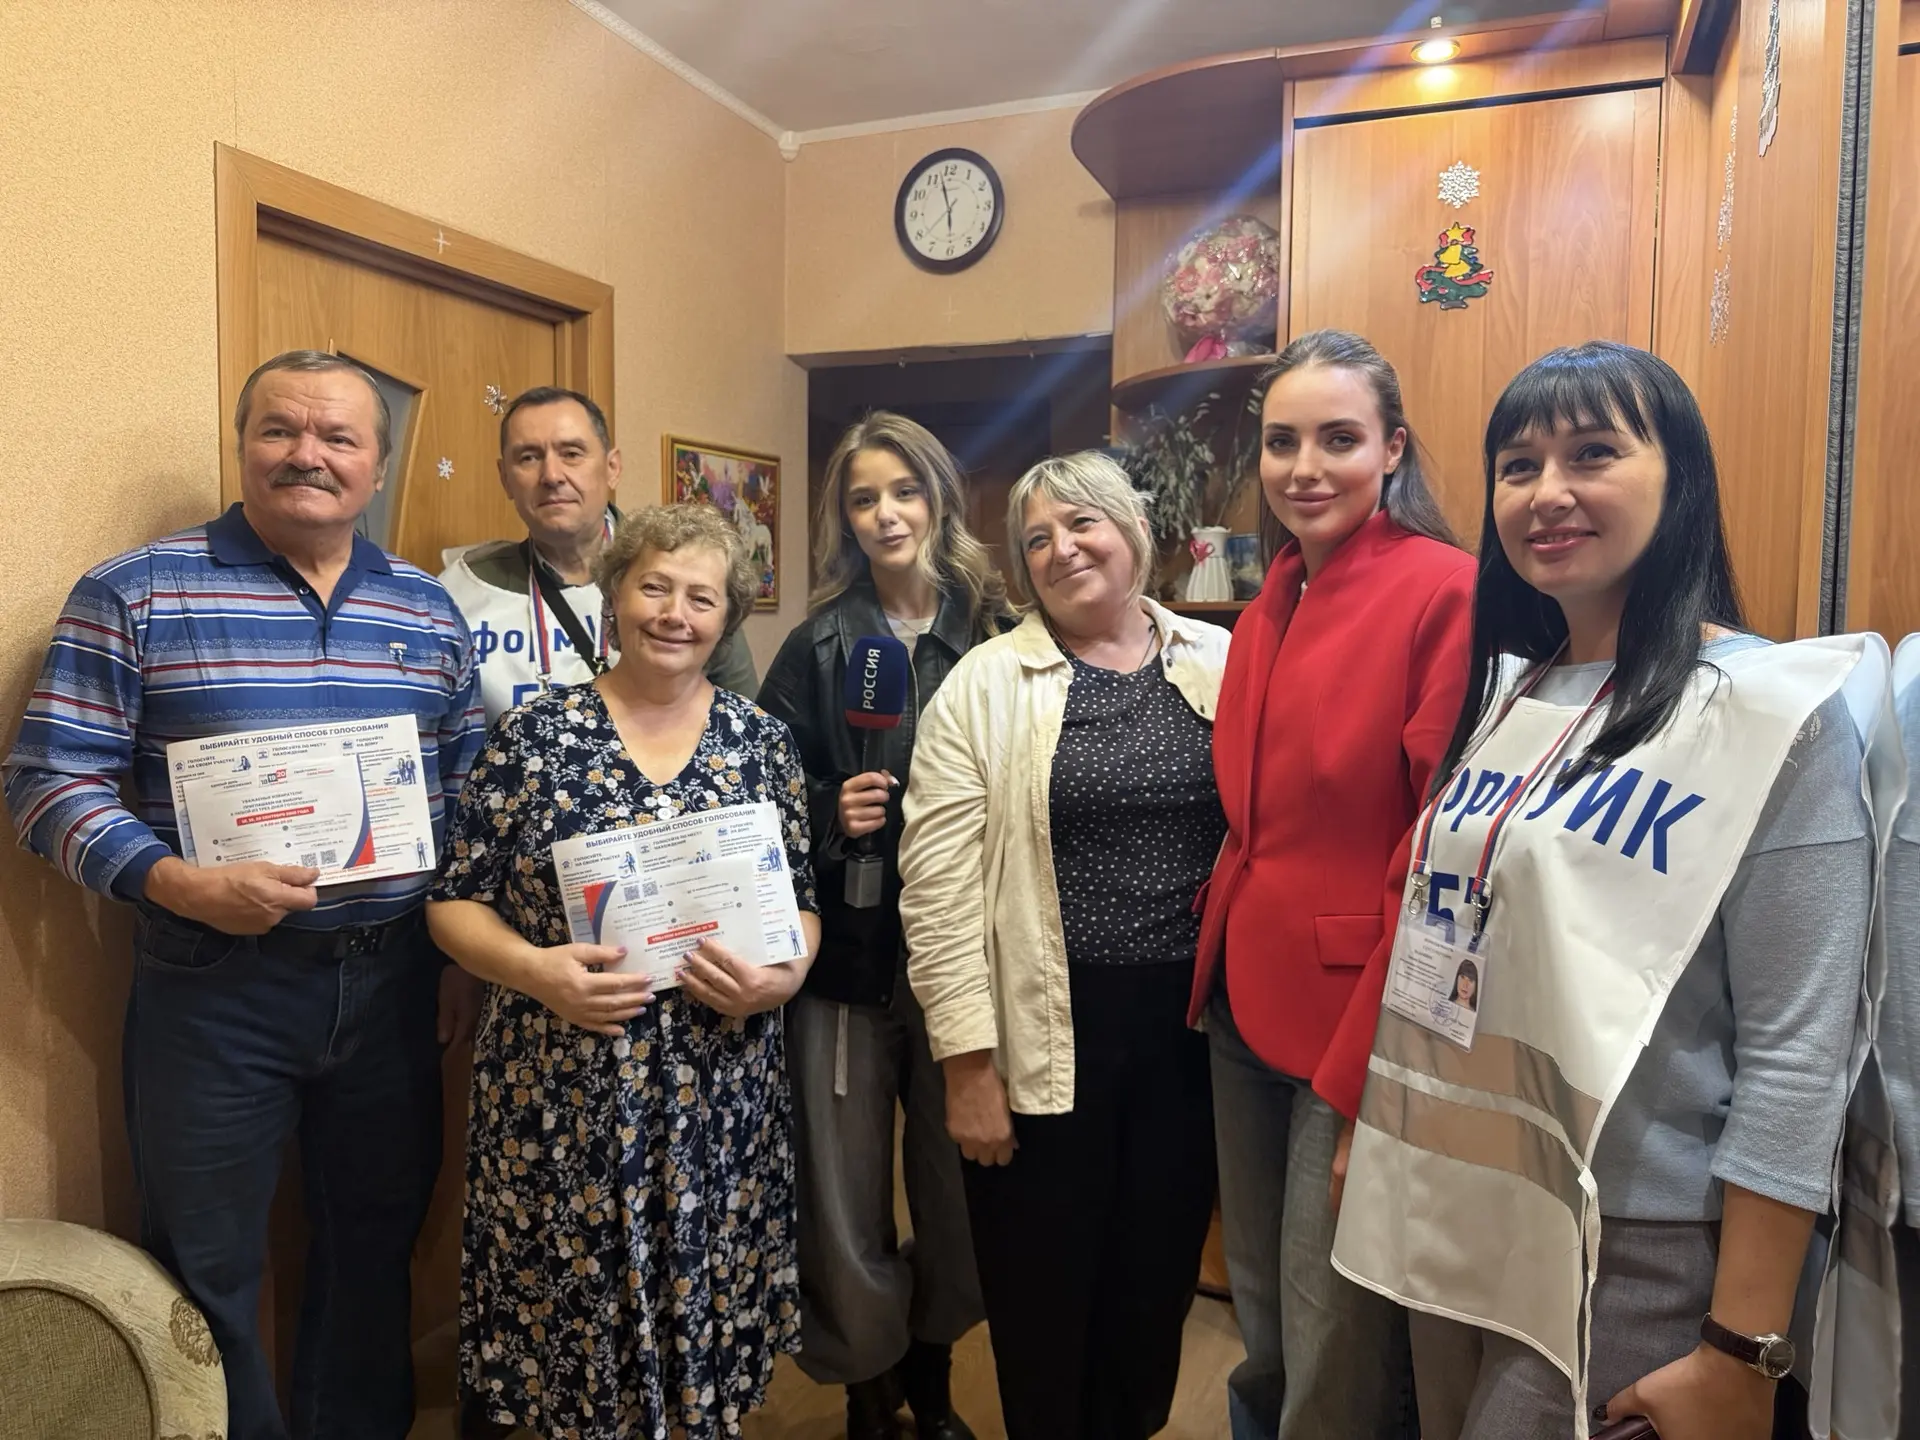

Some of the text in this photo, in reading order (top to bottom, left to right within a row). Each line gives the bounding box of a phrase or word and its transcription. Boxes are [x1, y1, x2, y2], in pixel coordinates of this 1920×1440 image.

[944, 164, 957, 177] 12
[966, 169, 972, 181] 1
[927, 174, 938, 186] 11
[978, 181, 986, 192] 2
[914, 189, 926, 202] 10
[983, 200, 992, 211] 3
[910, 210, 918, 221] 9
[980, 221, 985, 233] 4
[914, 230, 924, 241] 8
[928, 241, 936, 253] 7
[964, 236, 972, 248] 5
[946, 246, 955, 257] 6
[863, 648, 881, 711] РОССИЯ
[200, 723, 389, 751] ВЫБИРАЙТЕ УДОБНЫЙ СПОСОБ ГОЛОСОВАНИЯ
[586, 809, 756, 848] ВЫБИРАЙТЕ УДОБНЫЙ СПОСОБ ГОЛОСОВАНИЯ
